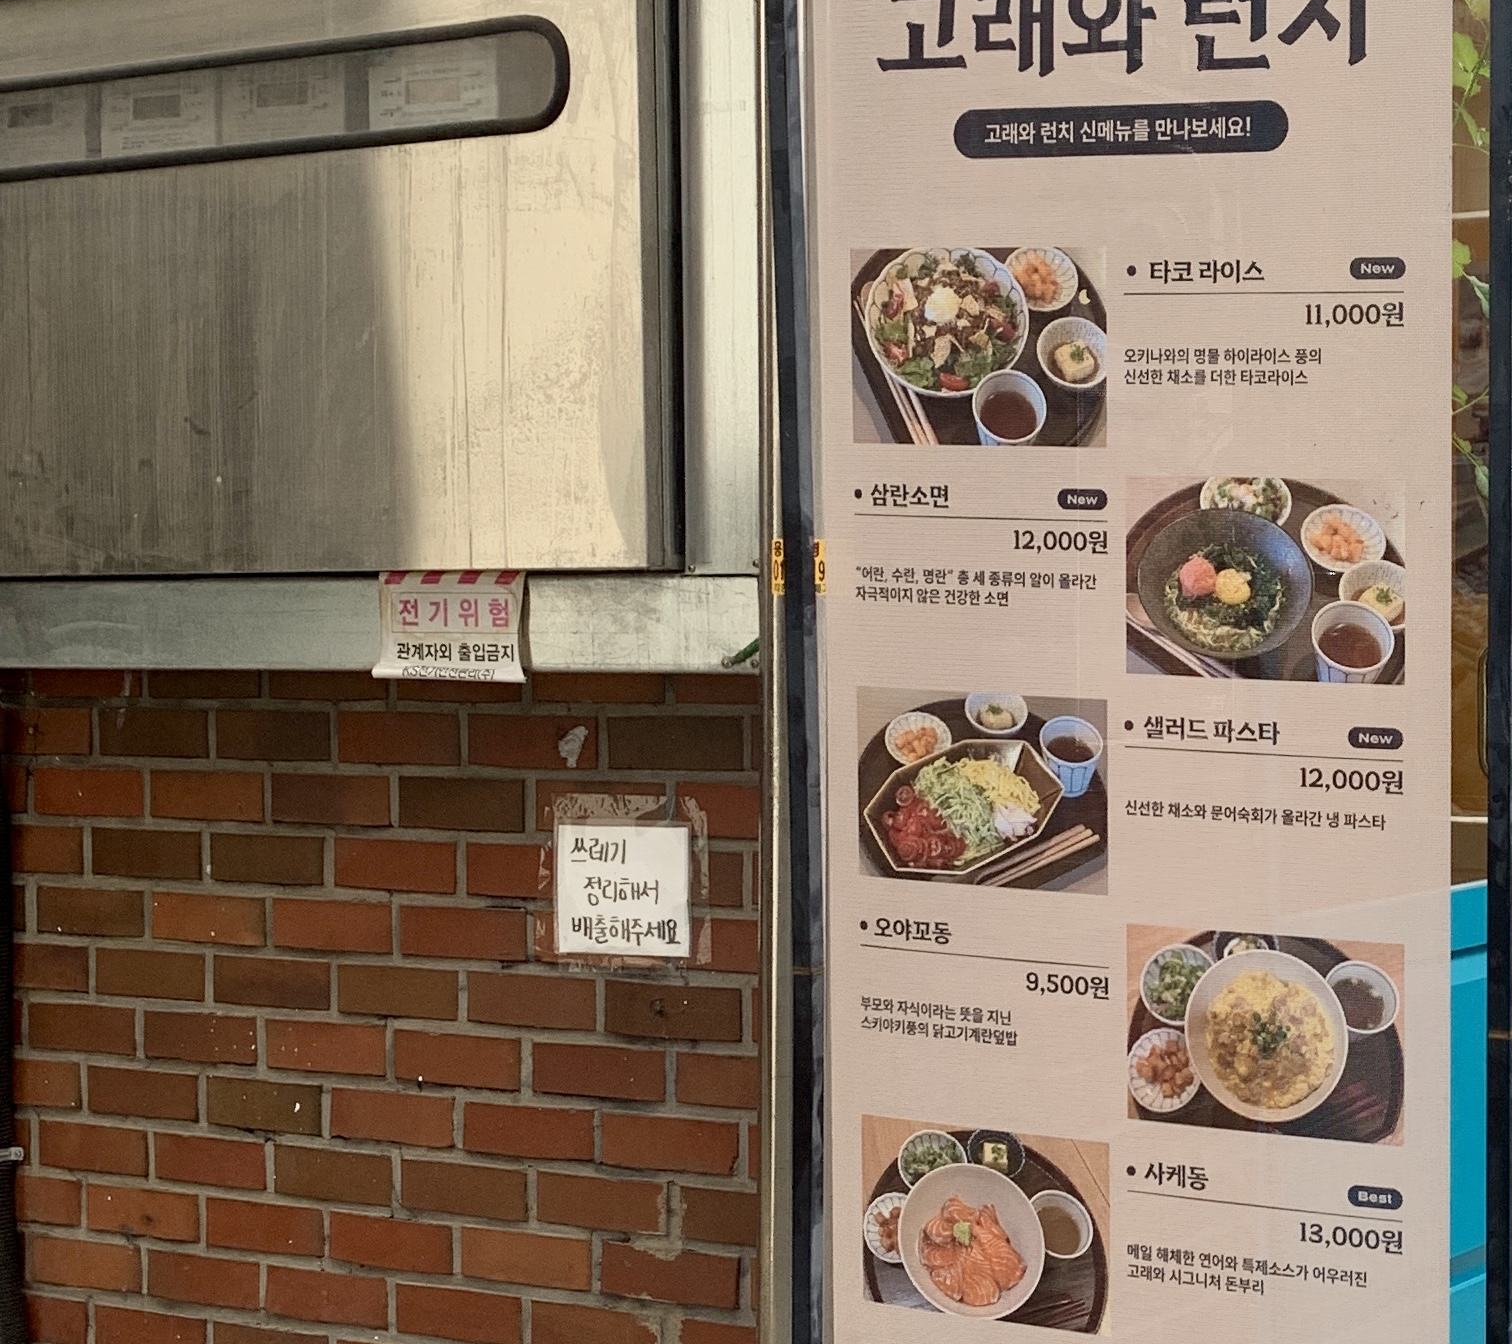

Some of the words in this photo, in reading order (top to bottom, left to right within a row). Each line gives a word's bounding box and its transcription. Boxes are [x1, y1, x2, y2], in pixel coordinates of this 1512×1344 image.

[984, 121, 1036, 145] 고래와
[1040, 120, 1075, 143] 런치
[1080, 118, 1150, 143] 신메뉴를
[1155, 116, 1252, 141] 만나보세요!
[1149, 259, 1194, 284] 타코
[1199, 259, 1265, 284] 라이스
[1360, 262, 1396, 275] New
[1304, 301, 1405, 328] 11,000원
[1124, 348, 1190, 365] 오키나와의
[1194, 348, 1220, 364] 명물
[1224, 347, 1291, 365] 하이라이스
[1295, 348, 1322, 365] 풍의
[1124, 369, 1163, 385] 신선한
[1167, 369, 1207, 385] 채소를
[1210, 369, 1236, 385] 더한
[1240, 369, 1308, 386] 타코라이스
[870, 483, 950, 509] 삼란소면
[1066, 493, 1099, 506] New
[1013, 529, 1109, 555] 12,000원
[891, 568, 919, 584] 수란,
[957, 570, 970, 585] 총
[973, 570, 986, 586] 세
[989, 570, 1026, 587] 종류의
[1029, 572, 1055, 589] 알이
[1058, 573, 1097, 590] 올라간
[855, 586, 913, 603] 자극적이지
[916, 587, 942, 604] 않은
[944, 589, 981, 606] 건강한
[984, 591, 1009, 607] 소면
[397, 642, 452, 662] 관계자외
[457, 643, 515, 662] 출입금지
[1144, 715, 1208, 741] 샐러드
[1213, 719, 1281, 745] 파스타
[1358, 732, 1393, 745] New
[1299, 767, 1404, 796] 12,000원
[1124, 799, 1164, 817] 신선한
[1167, 802, 1207, 821] 채소와
[1210, 805, 1277, 826] 문어숙회가
[1281, 809, 1322, 828] 올라간
[1326, 813, 1339, 829] 냉
[1343, 813, 1387, 831] 파스타
[583, 876, 660, 907] 정리해서
[571, 914, 682, 947] 배출해주세요
[873, 917, 953, 945] 오야꼬동
[1025, 972, 1110, 1001] 9,500원
[861, 996, 895, 1014] 부모와
[896, 1000, 957, 1021] 자식이라는
[959, 1006, 984, 1024] 뜻을
[987, 1009, 1012, 1026] 지닌
[861, 1015, 930, 1038] 스키야키풍의
[932, 1022, 1019, 1047] 닭고기계란덮밥
[1144, 1162, 1209, 1191] 사케동
[1357, 1190, 1393, 1205] Best
[1299, 1221, 1404, 1256] 13,000원
[1126, 1264, 1166, 1284] 고래와
[1169, 1269, 1222, 1292] 시그니처
[1224, 1275, 1265, 1296] 돈부리
[1199, 1251, 1239, 1272] 연어와
[1241, 1257, 1309, 1282] 특제소스가
[1312, 1266, 1368, 1289] 어우러진
